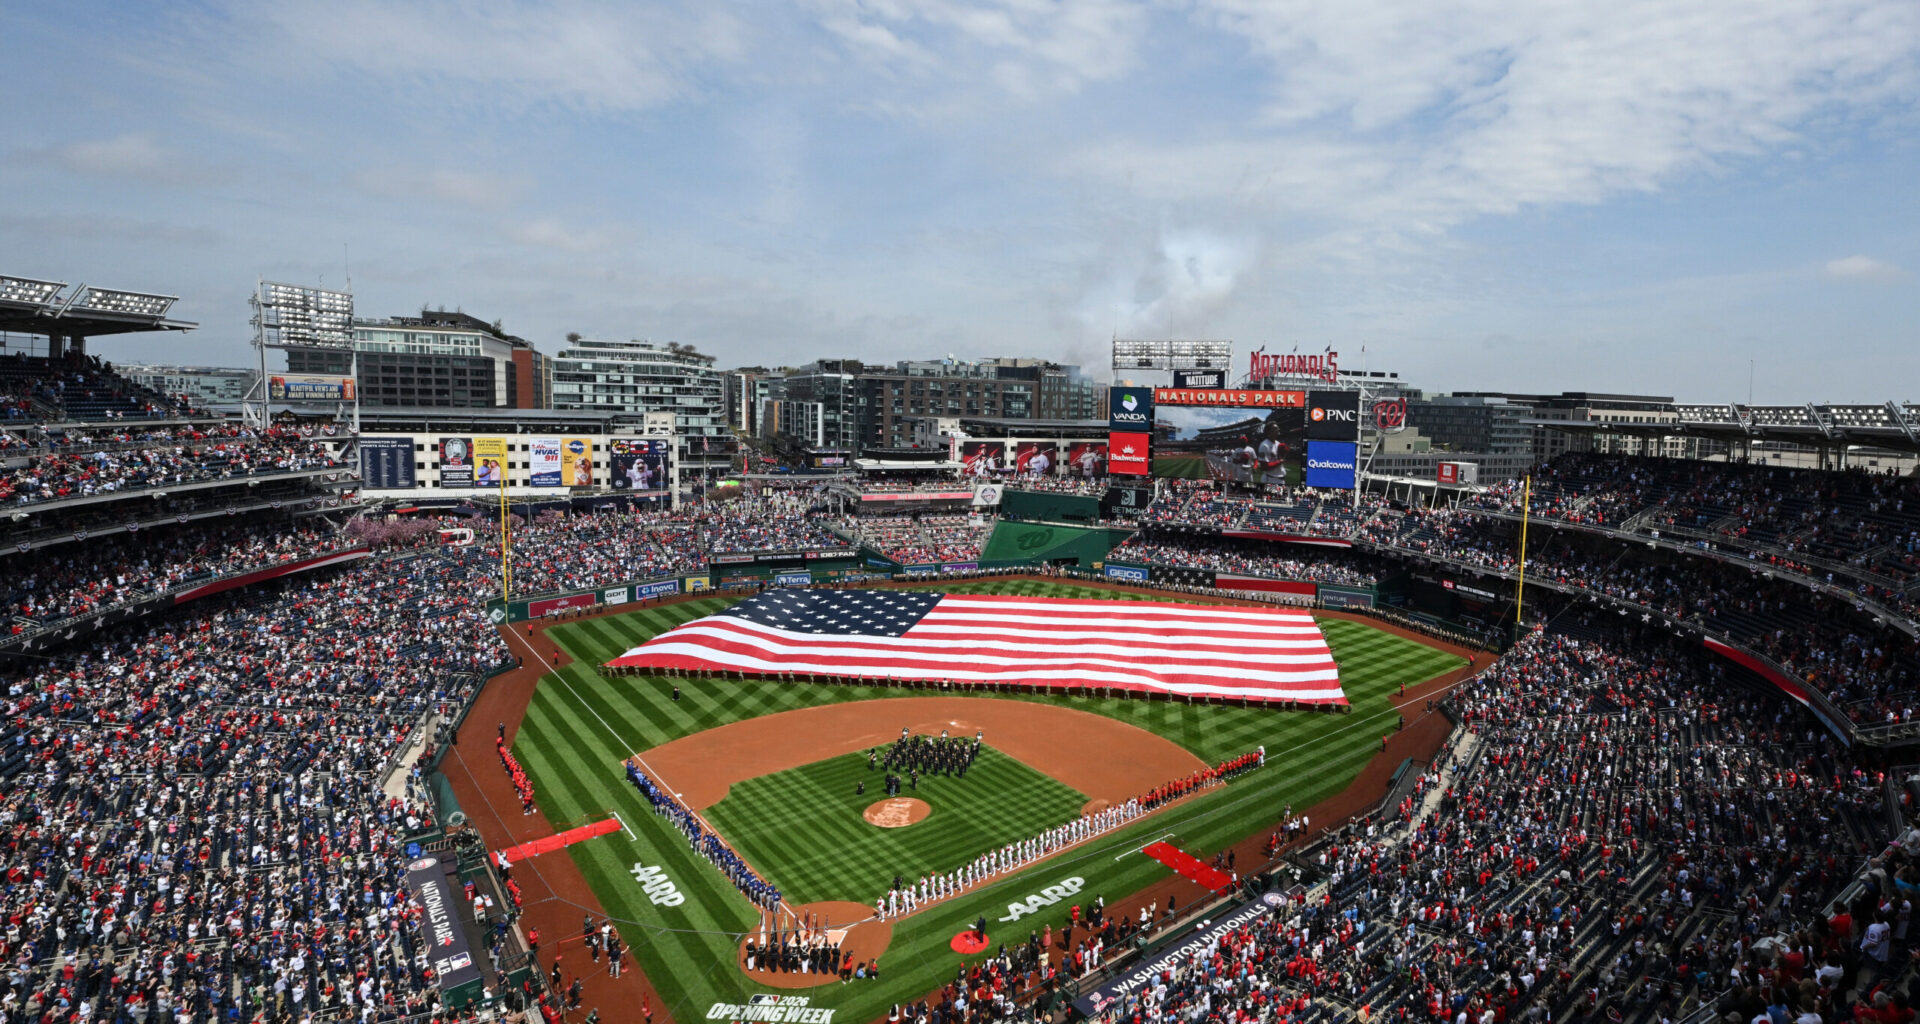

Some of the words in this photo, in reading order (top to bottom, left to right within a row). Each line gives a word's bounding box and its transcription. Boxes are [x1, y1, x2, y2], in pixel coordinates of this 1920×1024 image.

[1250, 352, 1337, 383] NATIONALS
[1186, 375, 1218, 386] NATITUDE
[1159, 391, 1247, 403] NATIONALS
[1254, 394, 1296, 404] PARK
[1326, 410, 1356, 421] PNC
[1111, 453, 1146, 462] Budweiser
[1308, 459, 1353, 470] Qualcomm
[1112, 506, 1145, 515] BETMGM
[1110, 569, 1142, 579] GEICO
[651, 584, 673, 592] Inova
[630, 862, 685, 906] AARP
[420, 880, 448, 923] NATIONALS
[999, 877, 1085, 922] AARP
[433, 920, 454, 946] PARK
[1112, 940, 1204, 993] WASHINGTON
[1200, 903, 1267, 944] NATIONALS
[435, 957, 452, 976] MLB
[778, 996, 810, 1006] 2026
[706, 1003, 786, 1022] OPENING
[784, 1006, 836, 1024] WEEK
